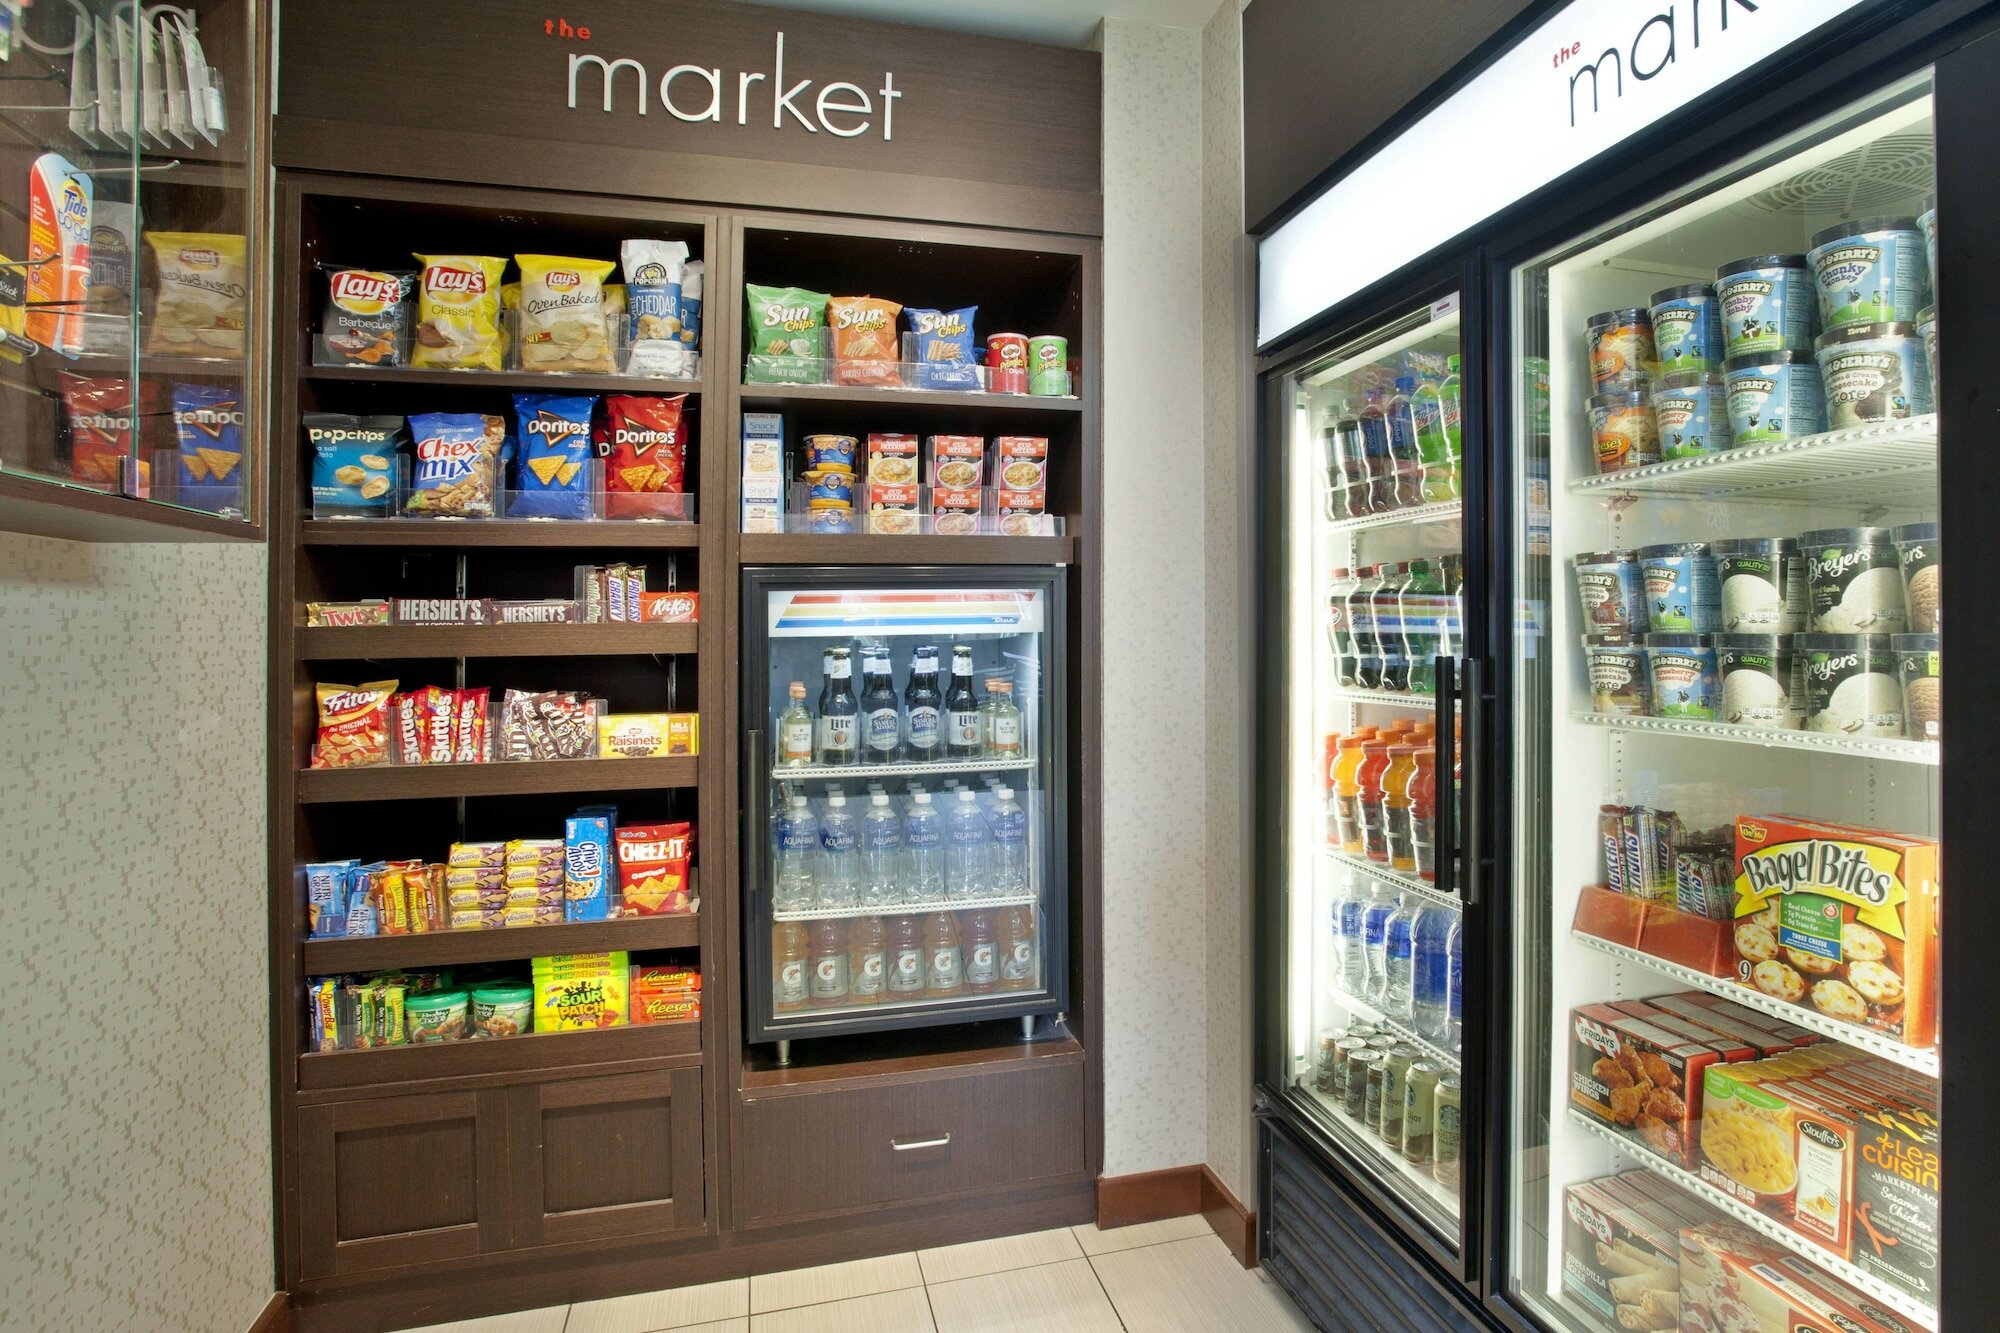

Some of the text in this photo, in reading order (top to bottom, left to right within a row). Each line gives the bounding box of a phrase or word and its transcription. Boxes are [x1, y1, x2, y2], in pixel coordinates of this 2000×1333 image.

[545, 19, 591, 40] the
[1552, 41, 1582, 69] the
[568, 32, 902, 140] market
[64, 189, 88, 218] Tide
[1833, 248, 1878, 262] JERRY'S
[427, 266, 485, 294] Lay's
[548, 271, 579, 286] Lay's
[634, 277, 668, 286] POPCORN
[1821, 262, 1866, 284] Chunky
[1825, 275, 1858, 288] Monkey
[337, 273, 396, 300] Lay's
[1732, 282, 1773, 294] JERRY'S
[561, 291, 600, 306] Baked
[635, 295, 677, 316] CHEDDAR
[1725, 296, 1756, 310] Chubby
[431, 304, 476, 318] Classic
[764, 304, 810, 326] Sun
[837, 306, 884, 329] Sun
[1662, 310, 1696, 321] JERRY'S
[1727, 305, 1754, 318] Hubby
[339, 316, 392, 330] Barbecue
[784, 318, 815, 333] Chips
[855, 318, 887, 333] Chips
[918, 312, 960, 334] Sun
[937, 323, 966, 338] Chips
[1838, 353, 1891, 369] JERRY'S
[1736, 380, 1775, 392] JERRY'S
[309, 428, 386, 444] popchips
[527, 419, 590, 436] Doritos
[749, 422, 776, 430] Snack
[616, 429, 676, 444] Doritos
[418, 437, 480, 460] Chex
[1737, 561, 1763, 569] QUALITY
[1807, 546, 1872, 584] Breyers
[609, 579, 624, 620] CRANKY
[627, 579, 641, 621] PRINCESS
[400, 600, 482, 620] HERSHEY'S
[503, 606, 566, 623] HERSHEY'S
[1600, 655, 1636, 668] JERRY'S
[1666, 656, 1703, 670] JERRY'S
[1741, 656, 1767, 665] QUALITY
[324, 690, 383, 716] Fritos
[338, 717, 372, 732] ORIGINAL
[431, 695, 453, 763] Skittles
[830, 718, 851, 731] Lite
[958, 715, 978, 726] Lite
[608, 733, 662, 746] Raisinets
[783, 836, 814, 845] AQUAFINA
[825, 836, 854, 846] AQUAFINA
[909, 833, 940, 844] AQUAFINA
[953, 830, 983, 840] AQUAFINA
[994, 828, 1023, 838] AQUAFINA
[580, 842, 598, 870] Chips
[1743, 840, 1892, 906] Bagel Bites
[312, 876, 322, 902] GRAIN
[321, 875, 332, 901] NUTRI
[1787, 902, 1820, 916] Real Cheese
[1795, 911, 1817, 923] Protein
[348, 909, 360, 936] NUTRI
[358, 908, 369, 936] GRAIN
[1795, 920, 1810, 930] Trans
[1810, 924, 1819, 932] Fat
[1792, 932, 1828, 947] THREE CHEESE
[934, 952, 952, 972] G
[973, 947, 992, 967] G
[1014, 943, 1030, 963] G
[817, 959, 836, 981] G
[864, 955, 882, 977] G
[898, 953, 917, 974] G
[1740, 960, 1752, 983] 9
[782, 964, 800, 985] G
[560, 990, 602, 1007] SOUR
[559, 1001, 606, 1020] PATCH
[1584, 1027, 1615, 1049] FRIDAYS
[1573, 1071, 1610, 1096] CHICKEN
[1573, 1080, 1600, 1101] WINGS
[1802, 1123, 1840, 1147] Stouffer's
[1896, 1139, 1938, 1173] Lea
[1880, 1186, 1920, 1213] Sesame
[1576, 1208, 1606, 1234] FRIDAYS
[1889, 1203, 1932, 1232] Chicken
[1566, 1251, 1606, 1289] QUESADILLA
[1870, 1254, 1918, 1285] PRESERVATIVES
